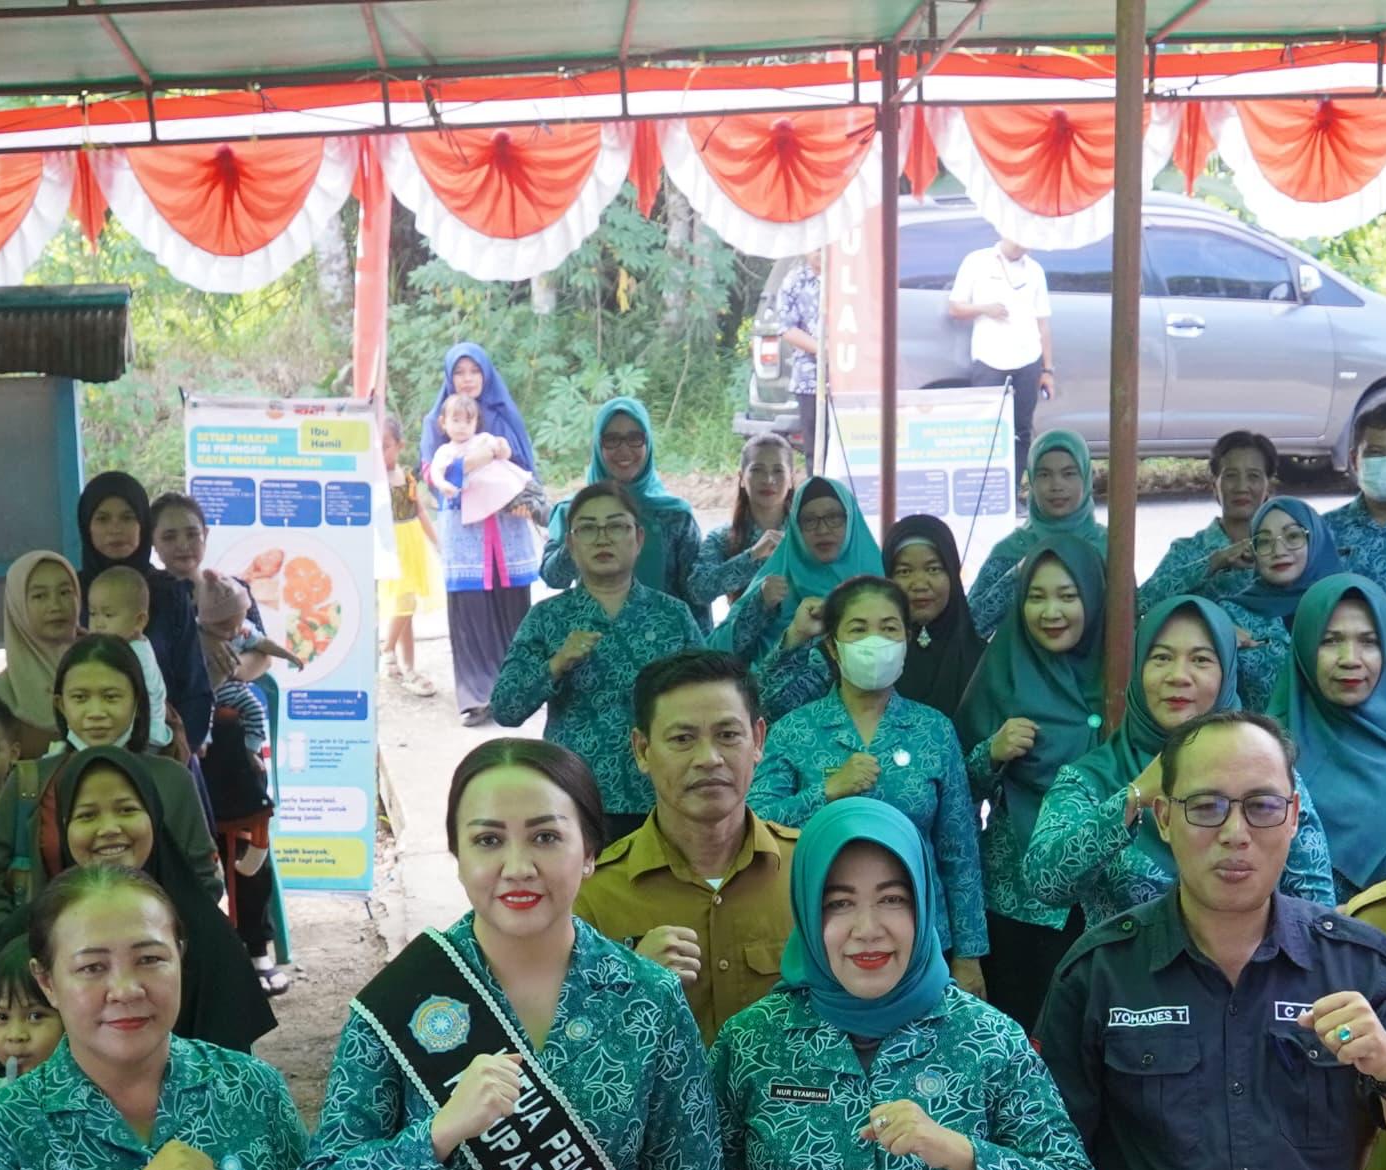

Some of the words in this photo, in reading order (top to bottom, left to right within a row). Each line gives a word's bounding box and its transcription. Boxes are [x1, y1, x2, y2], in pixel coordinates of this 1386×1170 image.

[311, 439, 342, 450] Hamil
[1113, 1010, 1173, 1024] YOHANES
[1176, 1010, 1185, 1021] T
[775, 1088, 792, 1097] NUR
[793, 1090, 828, 1100] SYAMSIAH
